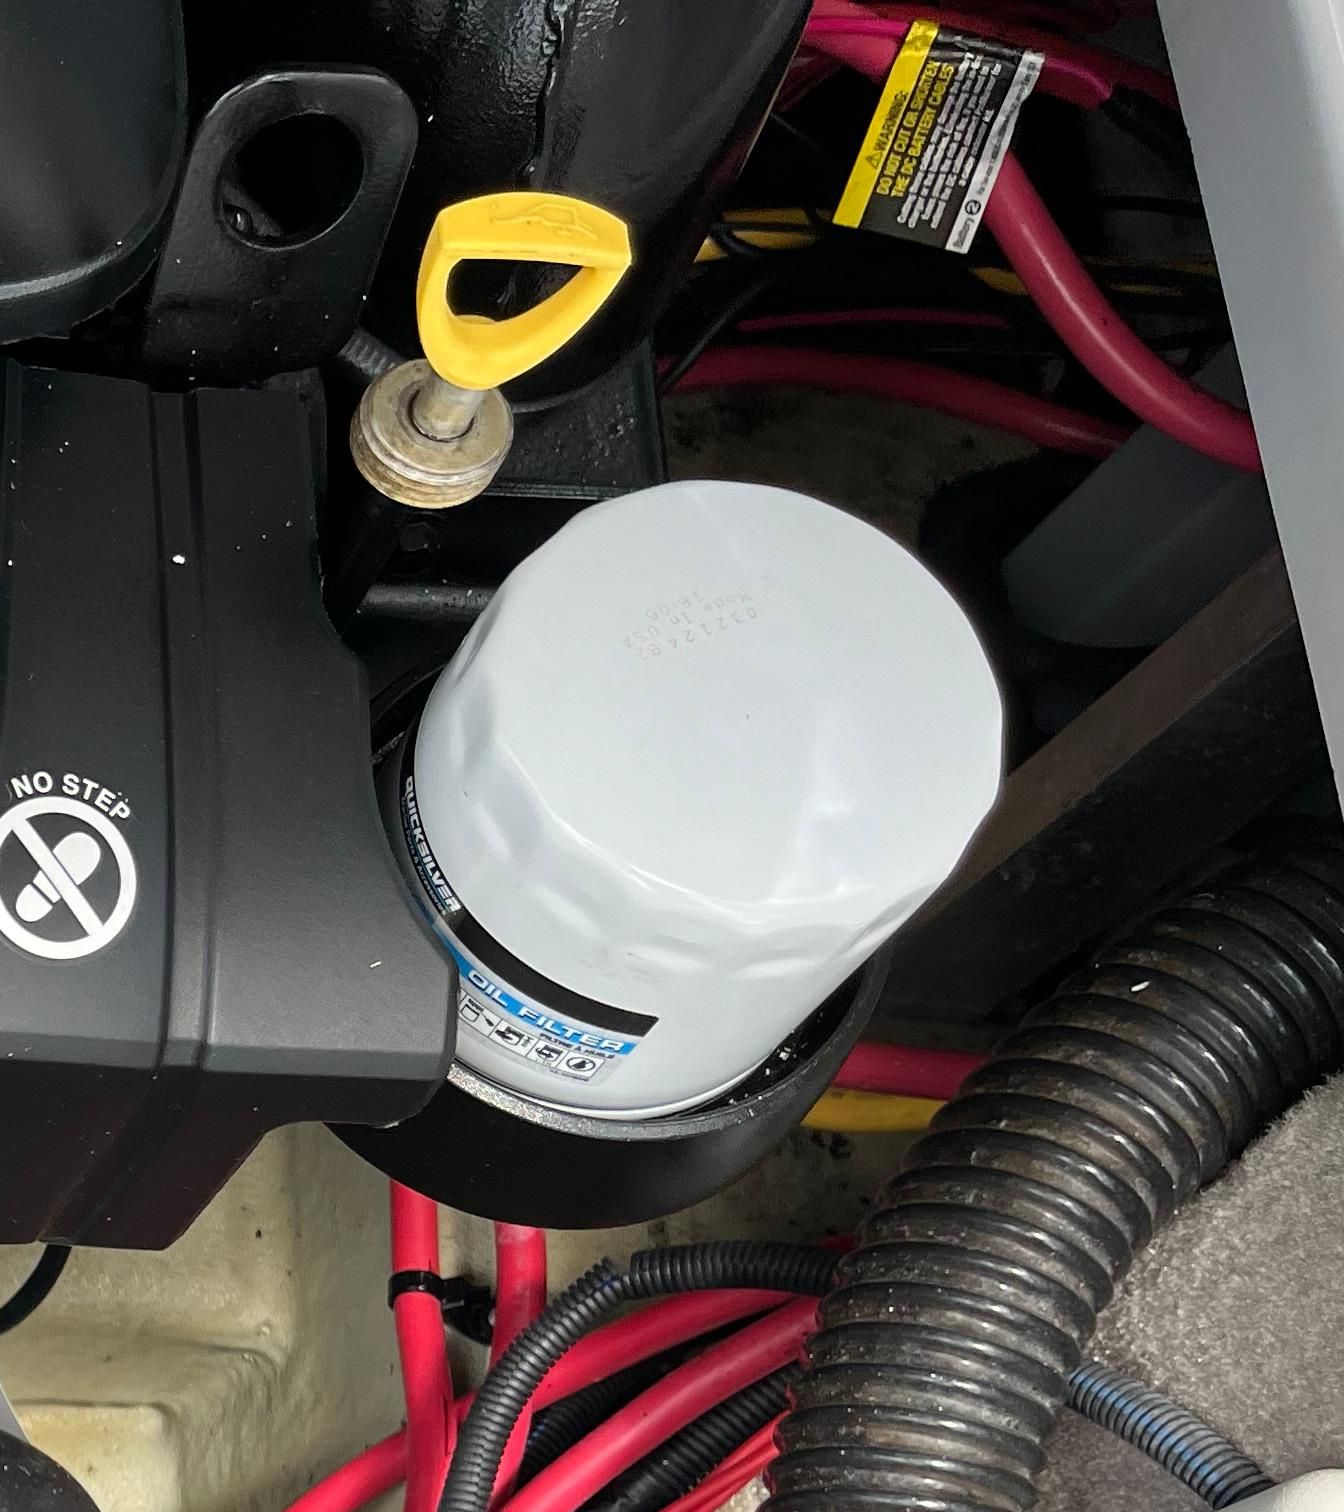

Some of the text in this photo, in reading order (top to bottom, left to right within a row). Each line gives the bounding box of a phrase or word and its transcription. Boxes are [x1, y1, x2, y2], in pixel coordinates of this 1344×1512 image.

[10, 770, 131, 820] NO STEP
[405, 775, 462, 912] QUICKSILVER
[468, 969, 625, 1051] OIL FILTER
